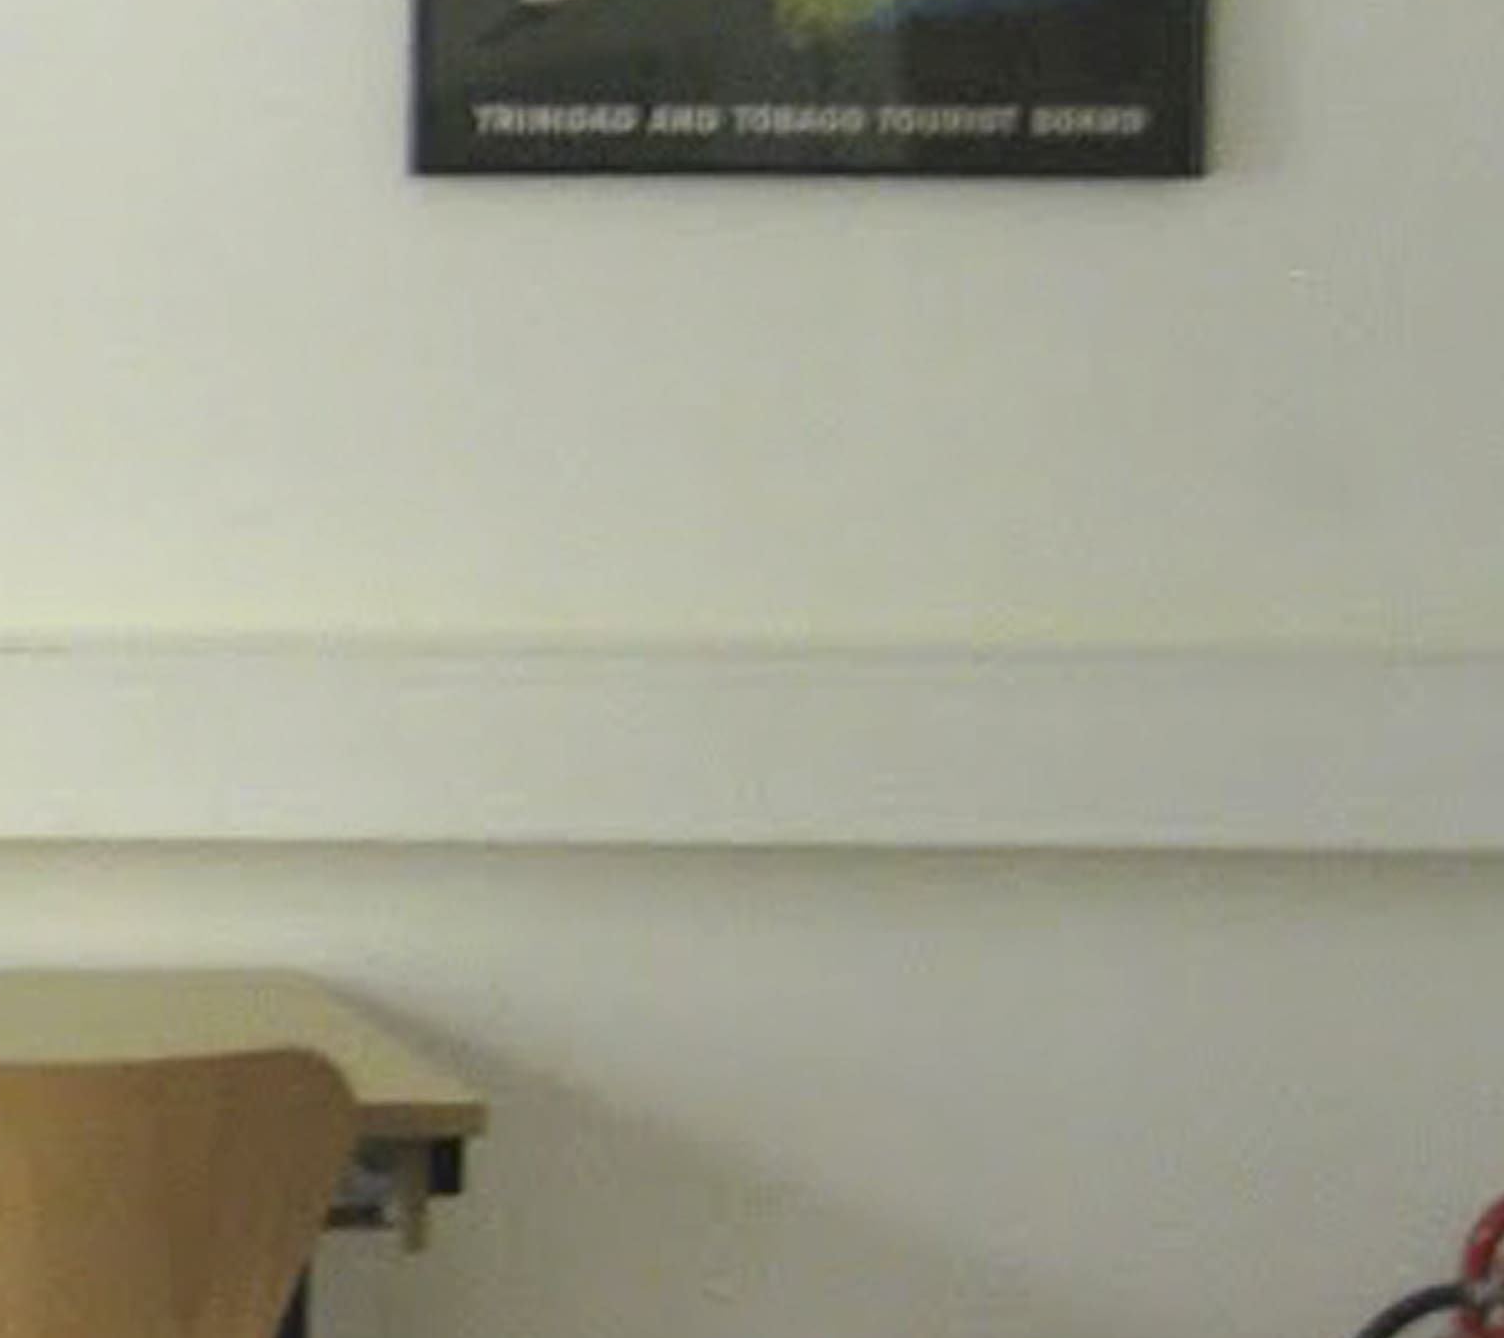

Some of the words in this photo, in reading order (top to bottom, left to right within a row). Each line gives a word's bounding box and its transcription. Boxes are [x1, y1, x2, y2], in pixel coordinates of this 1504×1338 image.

[474, 104, 640, 133] TRINIDAD
[645, 104, 720, 133] AND
[734, 105, 866, 134] TOBAGO
[876, 105, 1020, 134] TOURIST
